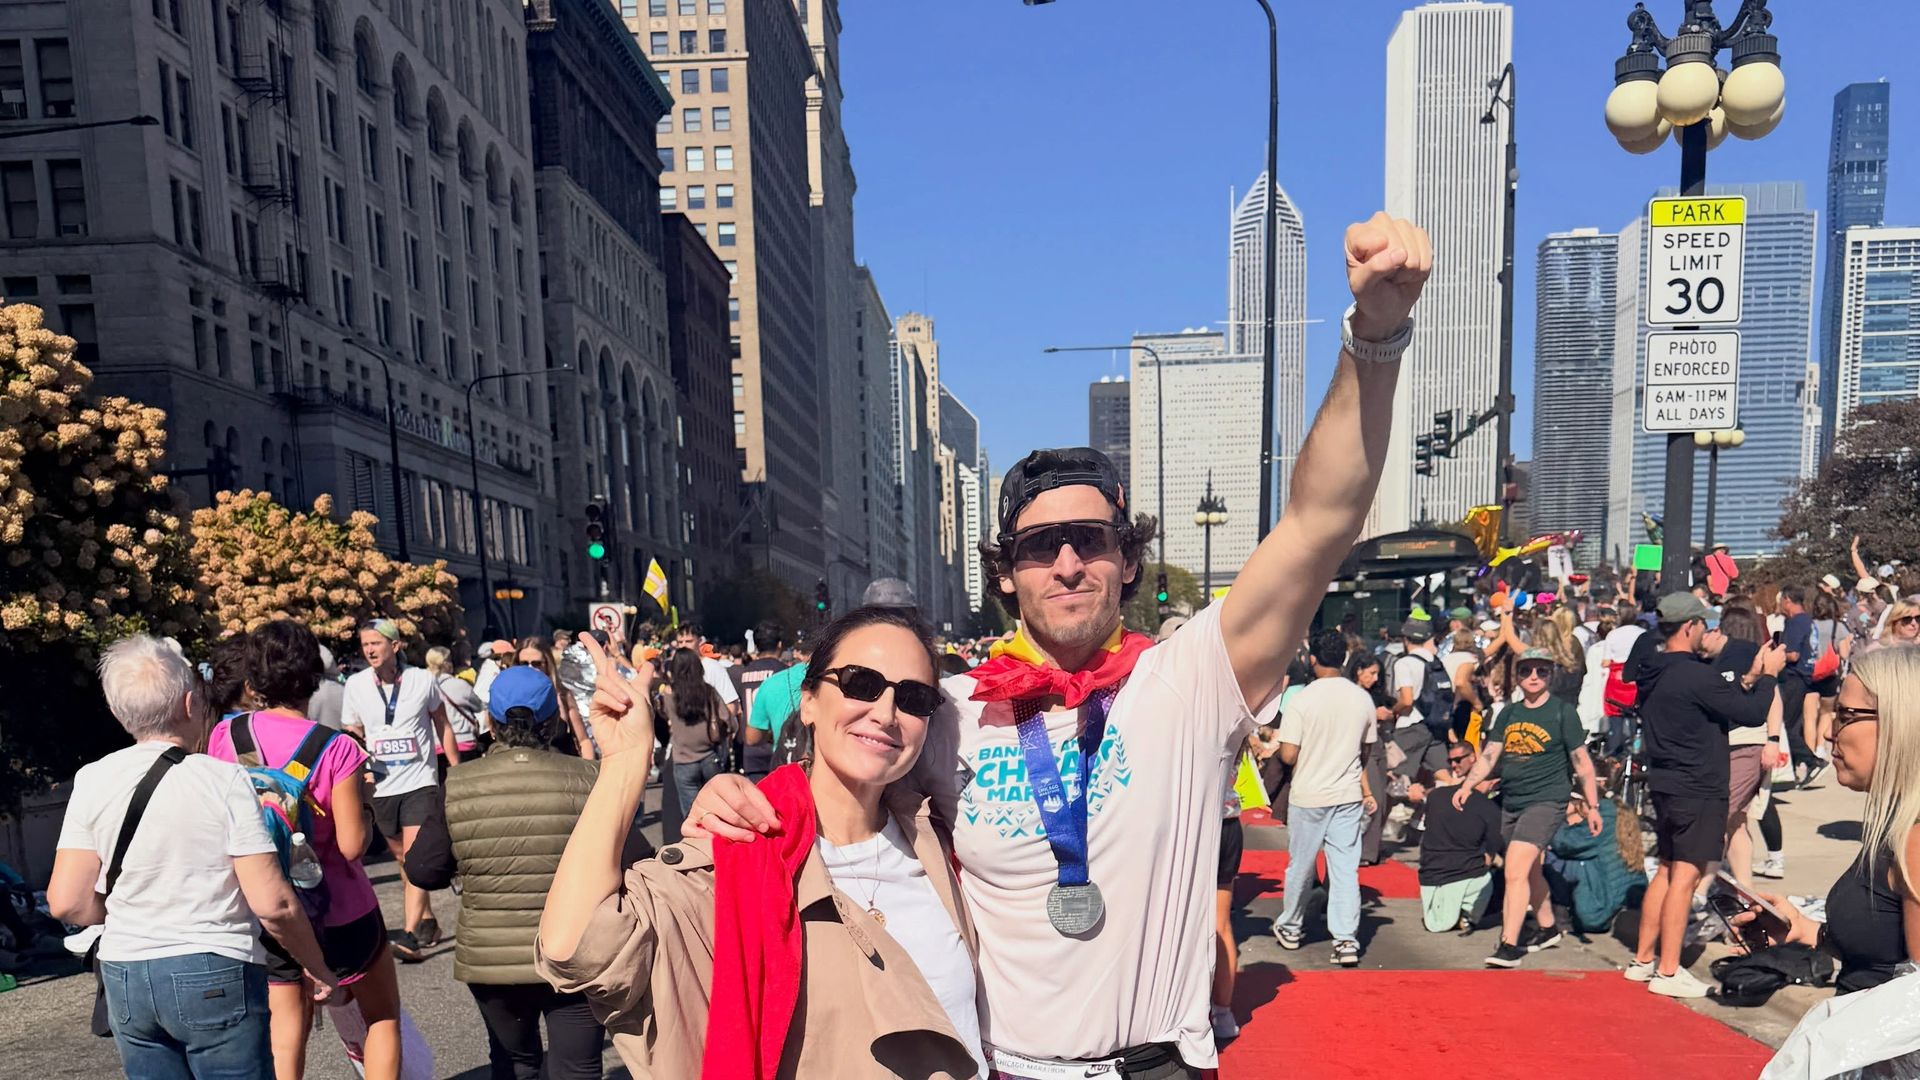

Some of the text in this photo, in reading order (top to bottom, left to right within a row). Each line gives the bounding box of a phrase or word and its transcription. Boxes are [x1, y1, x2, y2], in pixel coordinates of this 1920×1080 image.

[1672, 203, 1725, 222] PARK
[1663, 232, 1731, 249] SPEED
[1670, 254, 1723, 271] LIMIT
[1664, 277, 1725, 315] 30
[1669, 340, 1717, 355] PHOTO
[1654, 361, 1730, 376] ENFORCED
[1656, 407, 1725, 421] ALL DAYS
